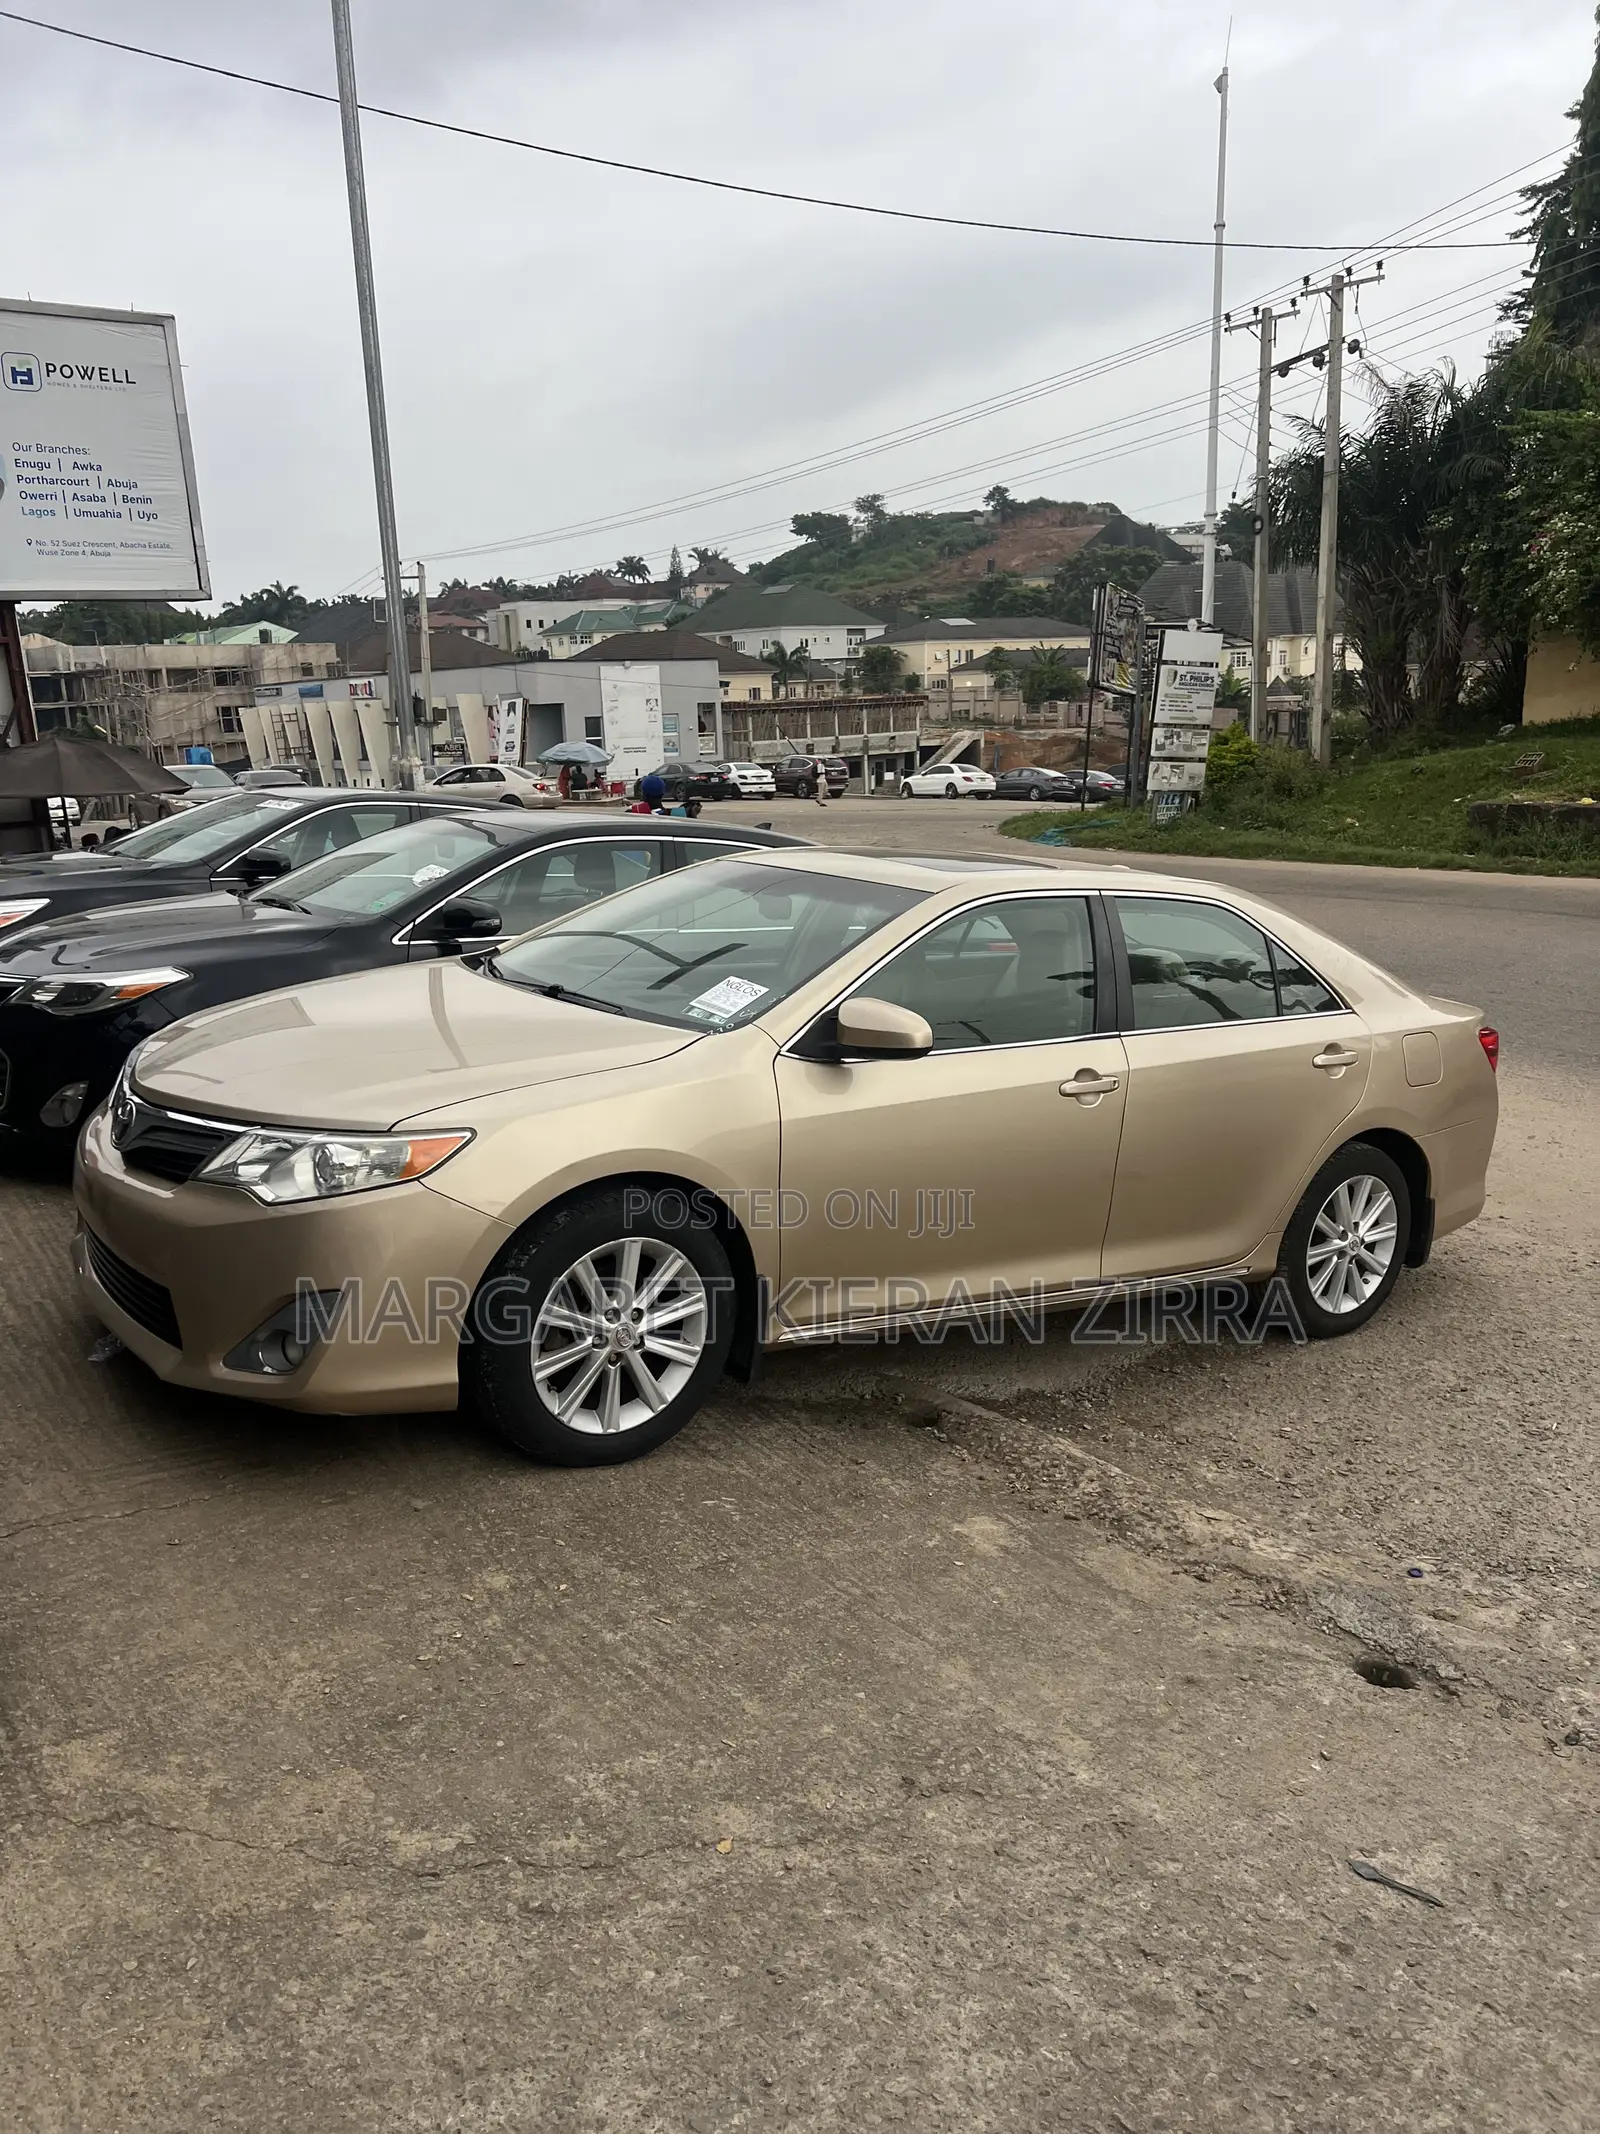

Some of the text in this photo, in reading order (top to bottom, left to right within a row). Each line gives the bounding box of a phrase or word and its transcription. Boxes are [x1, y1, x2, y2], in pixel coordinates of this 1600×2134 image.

[45, 362, 137, 385] POWELL
[12, 442, 91, 455] Our Branches:
[14, 459, 103, 472] Enugu Awka
[16, 474, 138, 491] Portharcourt Abuja
[19, 490, 153, 505] Owerri Asaba Benin
[21, 506, 158, 521] Lagos Umuahia Uyo
[62, 540, 81, 548] Suez
[82, 540, 118, 549] Crescent,
[119, 541, 147, 549] Abacha
[60, 549, 80, 557] Zone
[90, 550, 111, 558] Abuja
[1189, 675, 1215, 683] PHILIP'S
